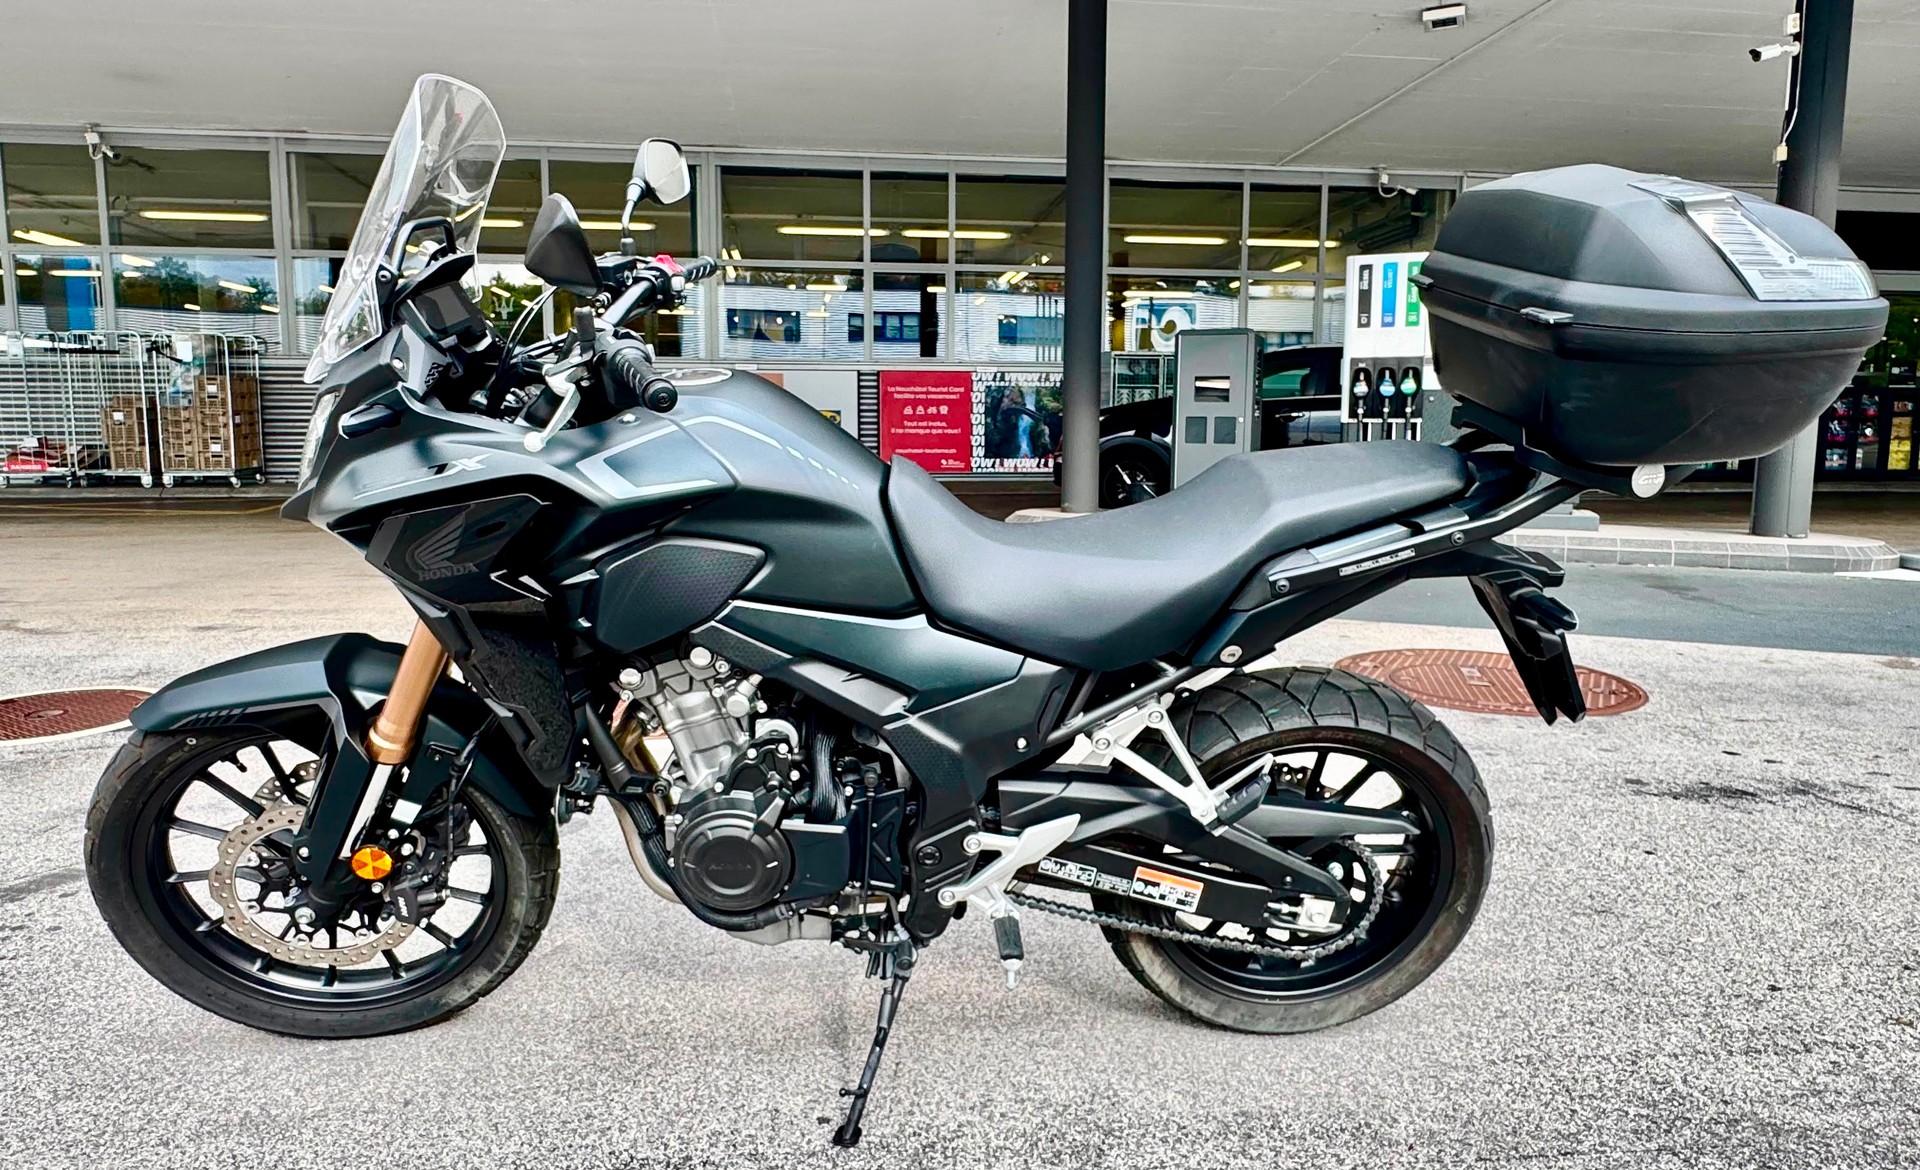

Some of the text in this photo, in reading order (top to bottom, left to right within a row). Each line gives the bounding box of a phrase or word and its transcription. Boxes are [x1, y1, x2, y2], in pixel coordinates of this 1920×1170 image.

[970, 457, 1000, 468] OW!
[1638, 473, 1664, 485] GIVI
[418, 562, 480, 581] HONDA
